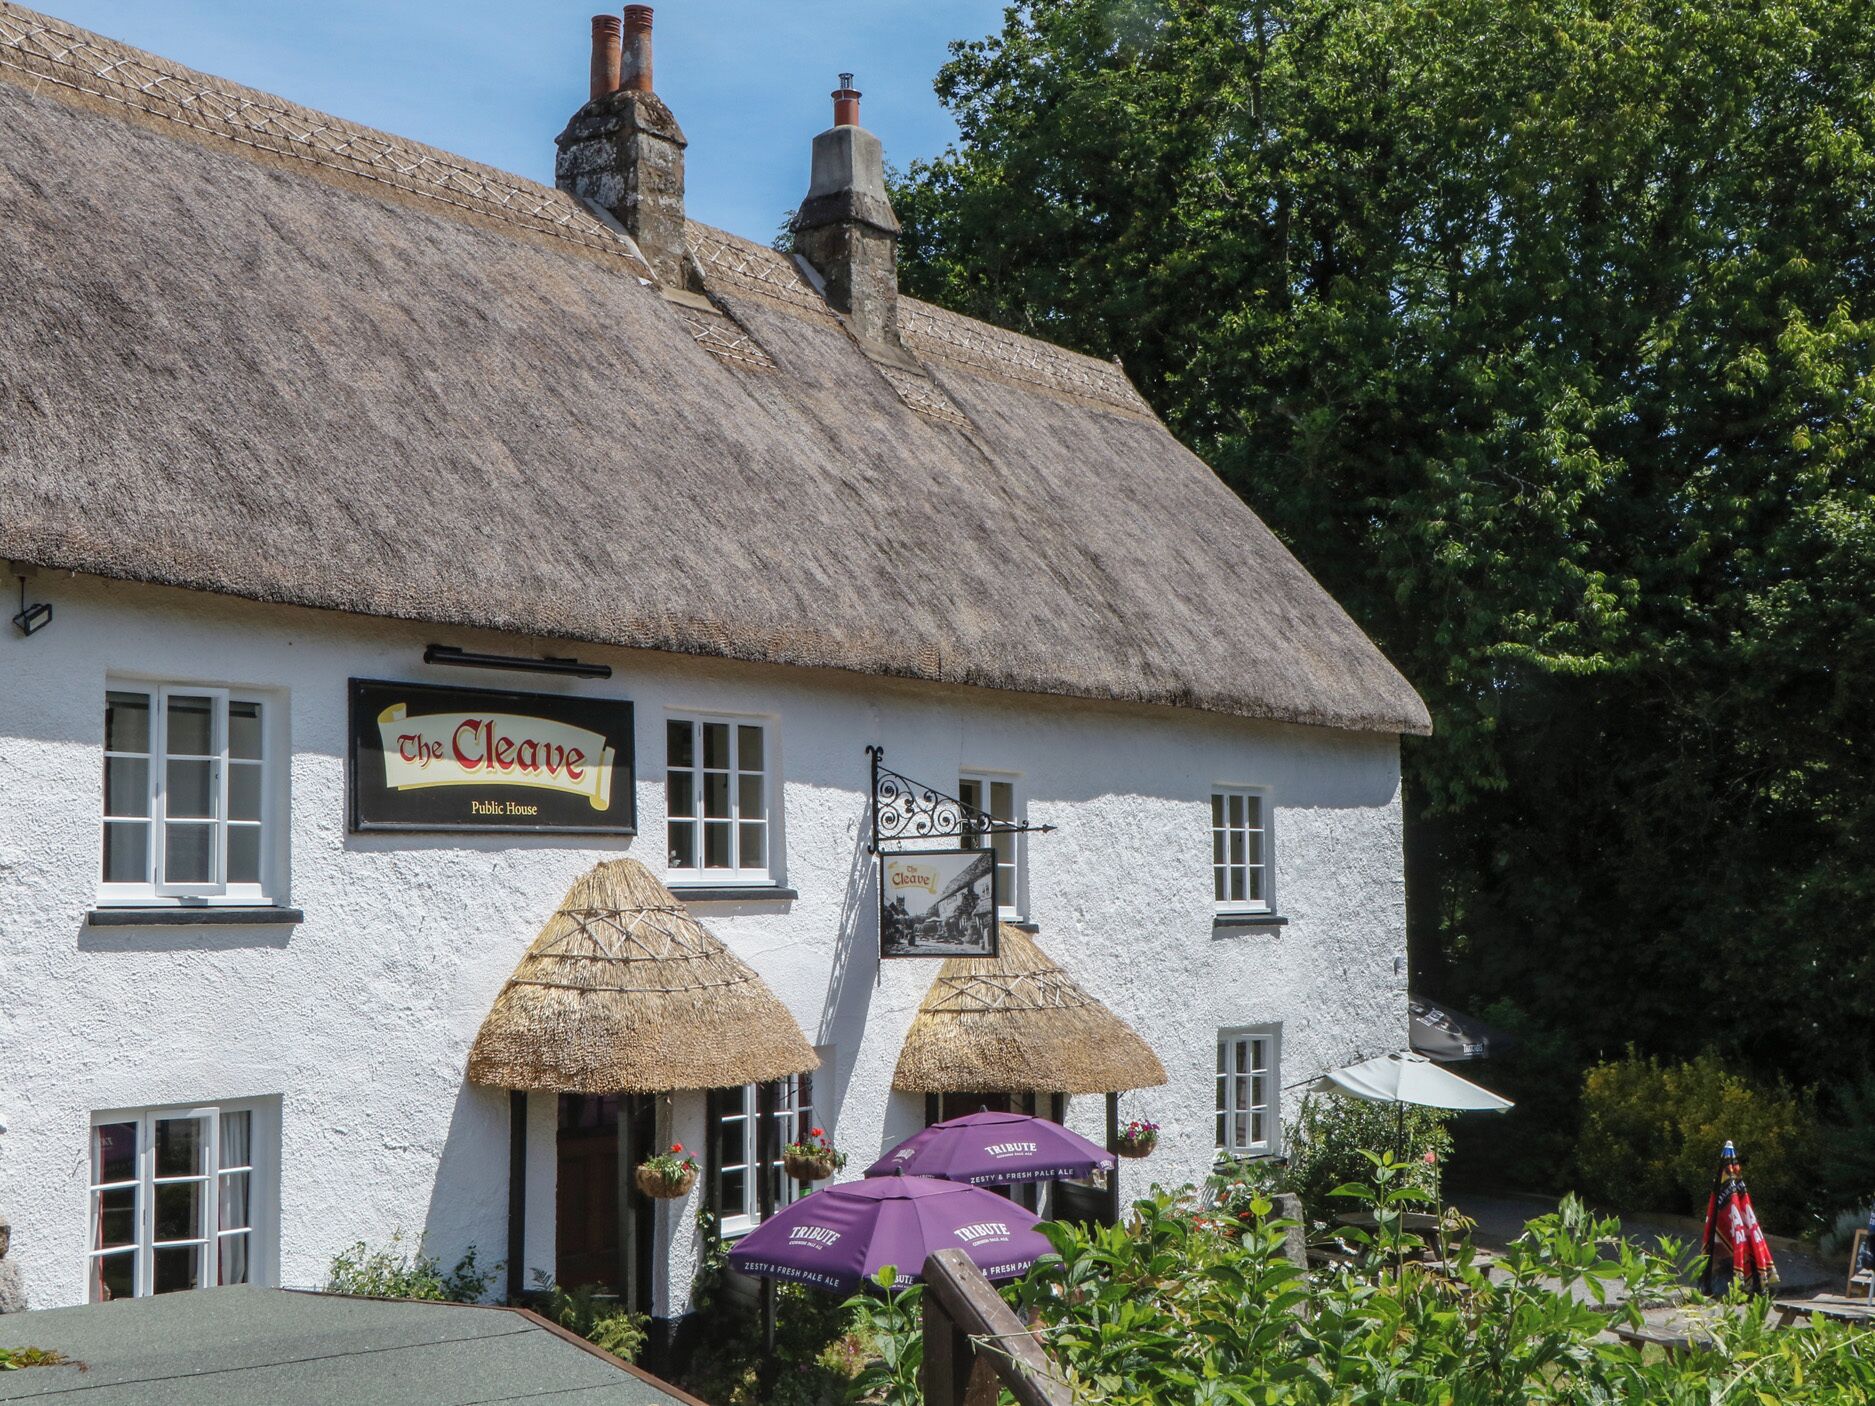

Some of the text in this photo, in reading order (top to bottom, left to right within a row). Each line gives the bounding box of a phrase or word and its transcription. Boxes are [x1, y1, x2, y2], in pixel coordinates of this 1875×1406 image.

[397, 719, 585, 780] The Cleave
[472, 801, 538, 815] Public House
[892, 872, 930, 885] Cleave
[984, 1142, 1037, 1155] TRIBUTE
[970, 1174, 995, 1183] ZESTY
[1006, 1171, 1032, 1179] FRESH
[1034, 1169, 1055, 1177] PALE
[789, 1226, 841, 1246] TRIBUTE
[953, 1223, 1011, 1242] TRIBUTE
[744, 1262, 769, 1271] ZESTY
[776, 1266, 801, 1277] FRESH
[802, 1271, 823, 1281] PALE
[824, 1276, 840, 1287] ALE
[990, 1264, 1016, 1275] FRESH
